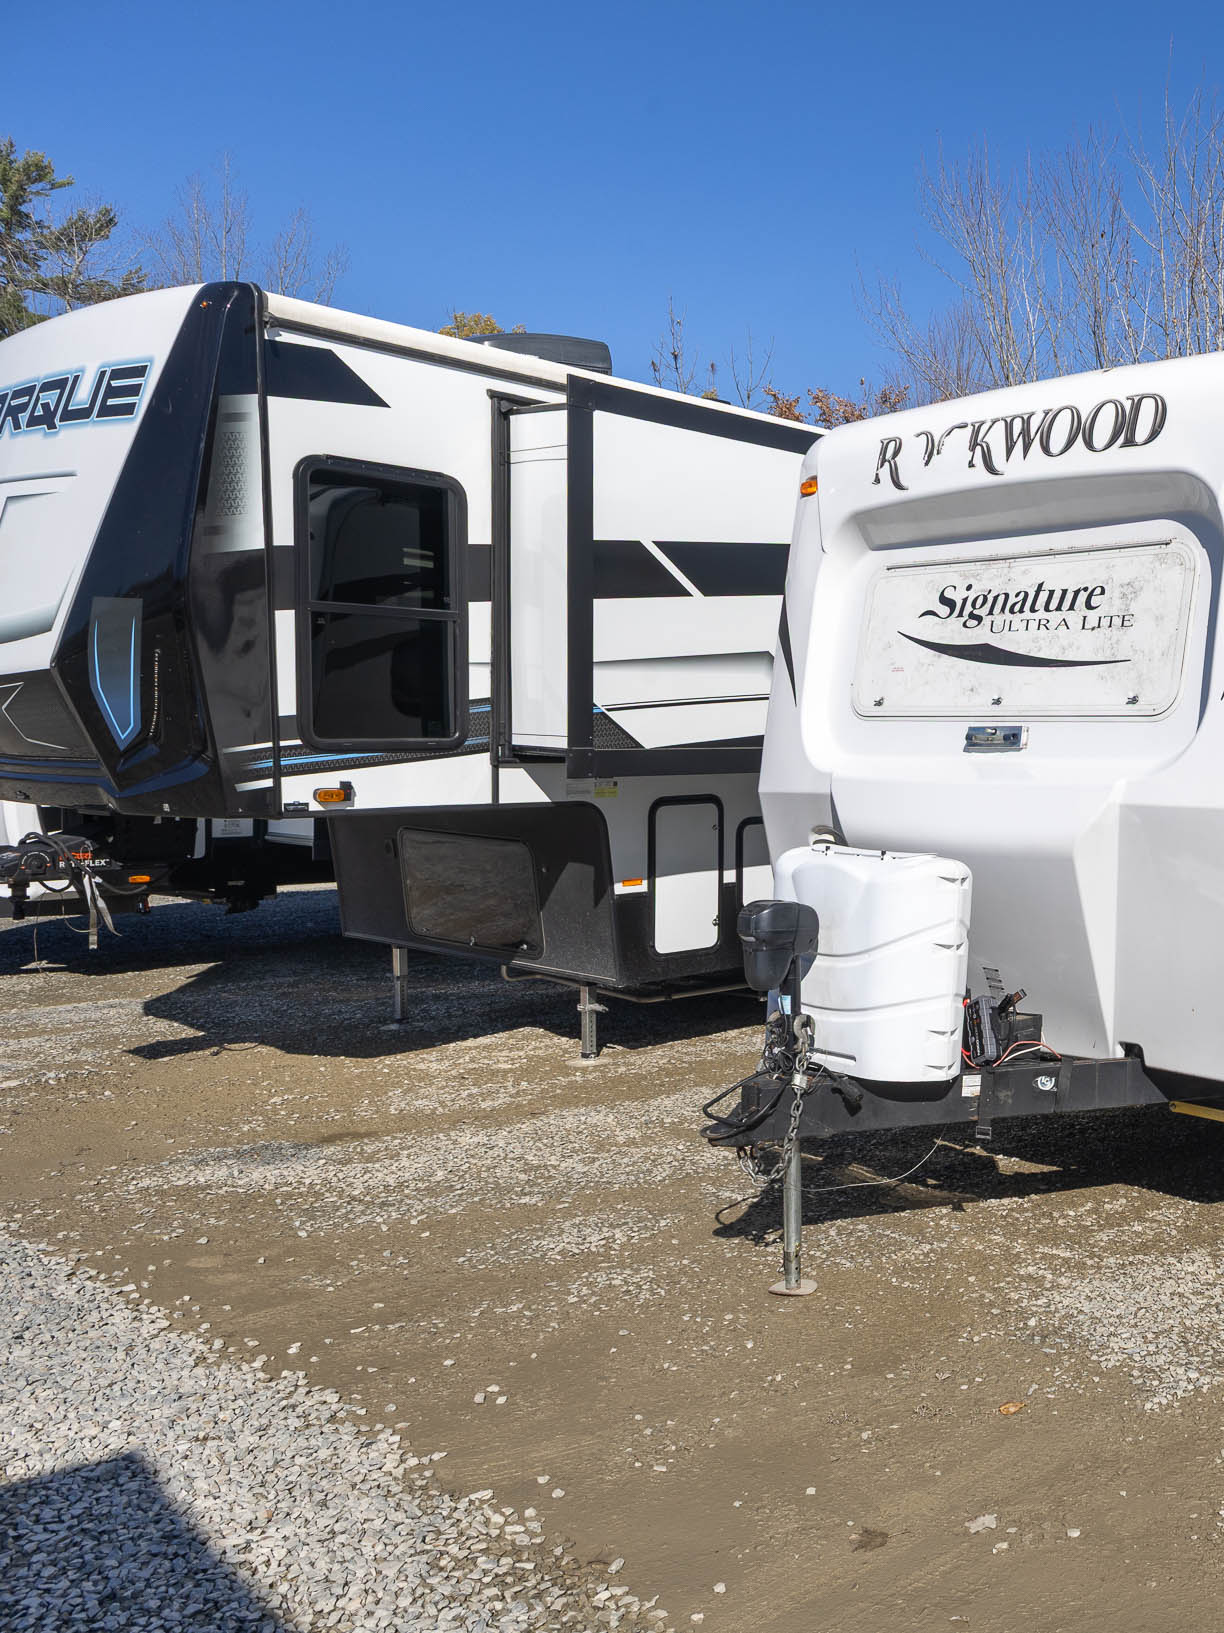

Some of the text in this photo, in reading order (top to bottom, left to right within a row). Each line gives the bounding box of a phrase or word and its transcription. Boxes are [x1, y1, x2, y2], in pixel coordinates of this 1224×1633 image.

[918, 580, 1106, 629] Signature
[989, 613, 1135, 634] ULTRA LITE
